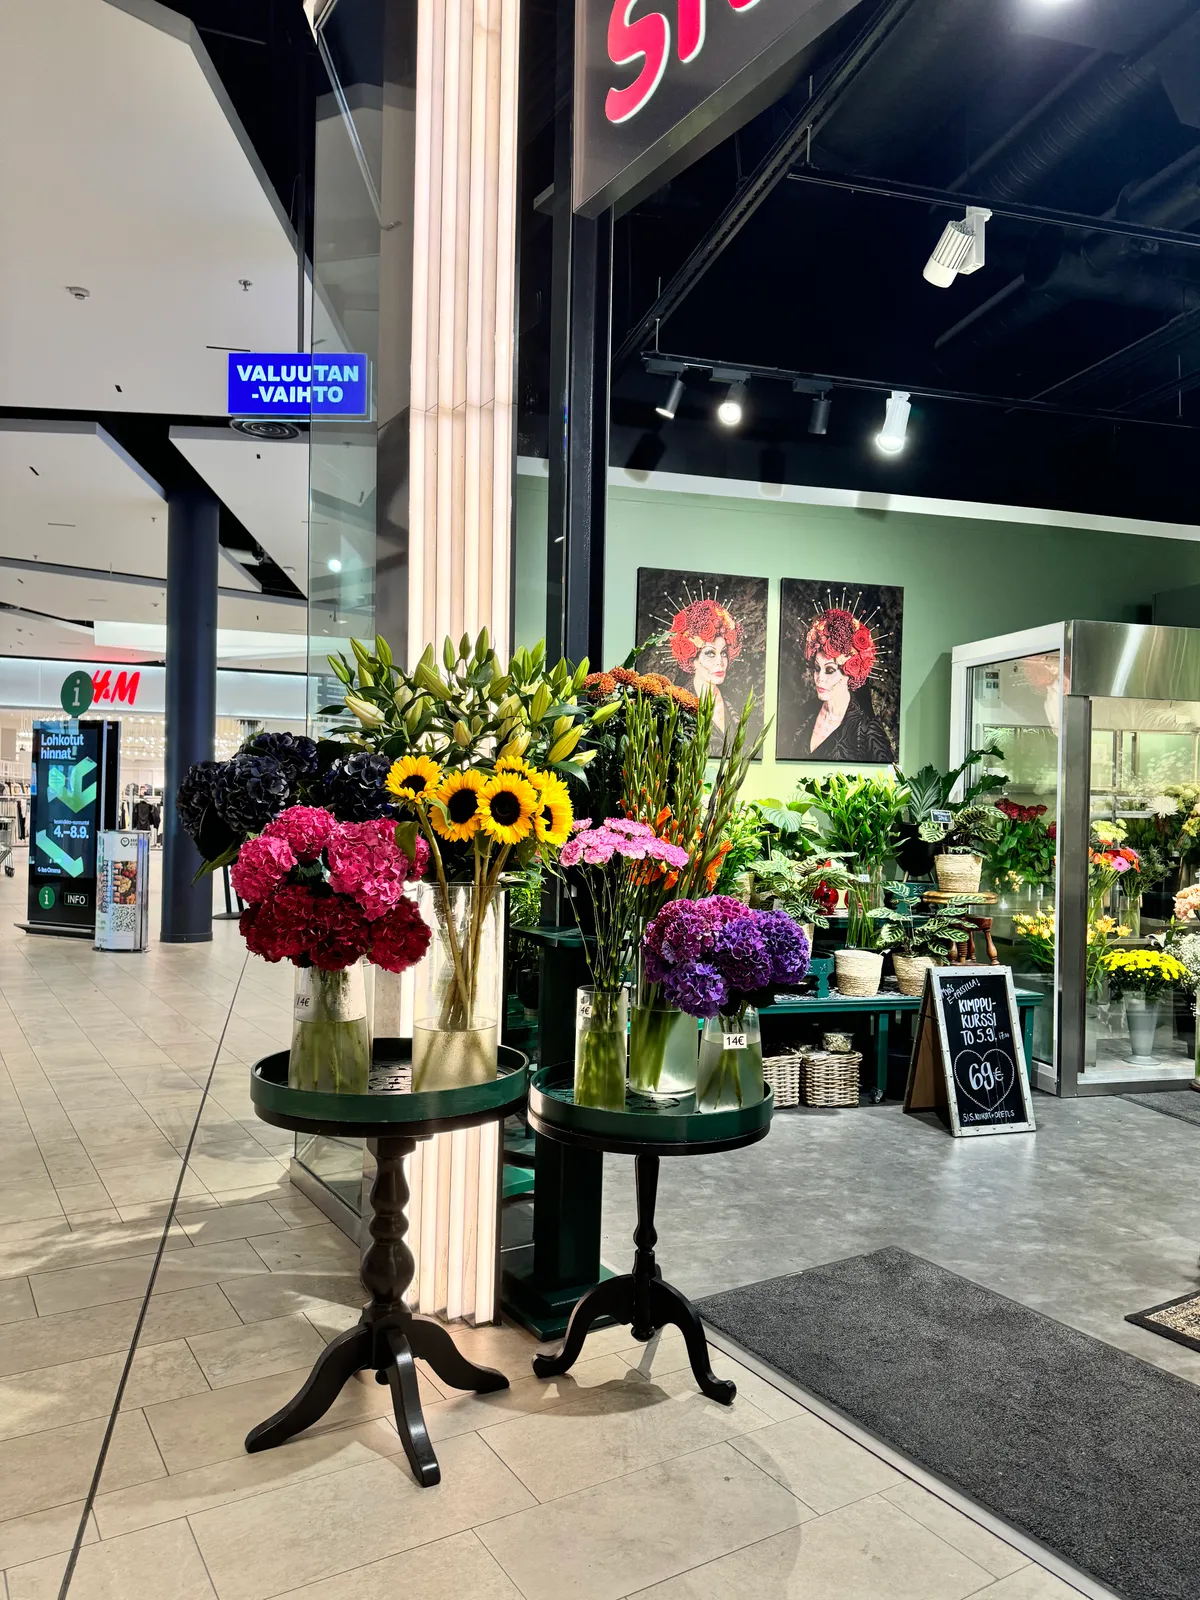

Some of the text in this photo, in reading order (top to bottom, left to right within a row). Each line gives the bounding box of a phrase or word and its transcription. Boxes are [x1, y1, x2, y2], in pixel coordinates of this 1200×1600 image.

[236, 365, 359, 382] VALUUTAN
[252, 386, 344, 403] -VAIHTO
[92, 669, 141, 706] H&M
[41, 733, 85, 746] Lohkotut
[67, 894, 86, 905] INFO
[296, 997, 310, 1007] 14€
[958, 997, 997, 1013] KIMPPU-
[960, 1012, 997, 1029] KURSSI
[726, 1035, 745, 1046] 14€
[960, 1030, 974, 1046] TO
[976, 1027, 998, 1043] 5.9.
[968, 1061, 1004, 1090] 69€
